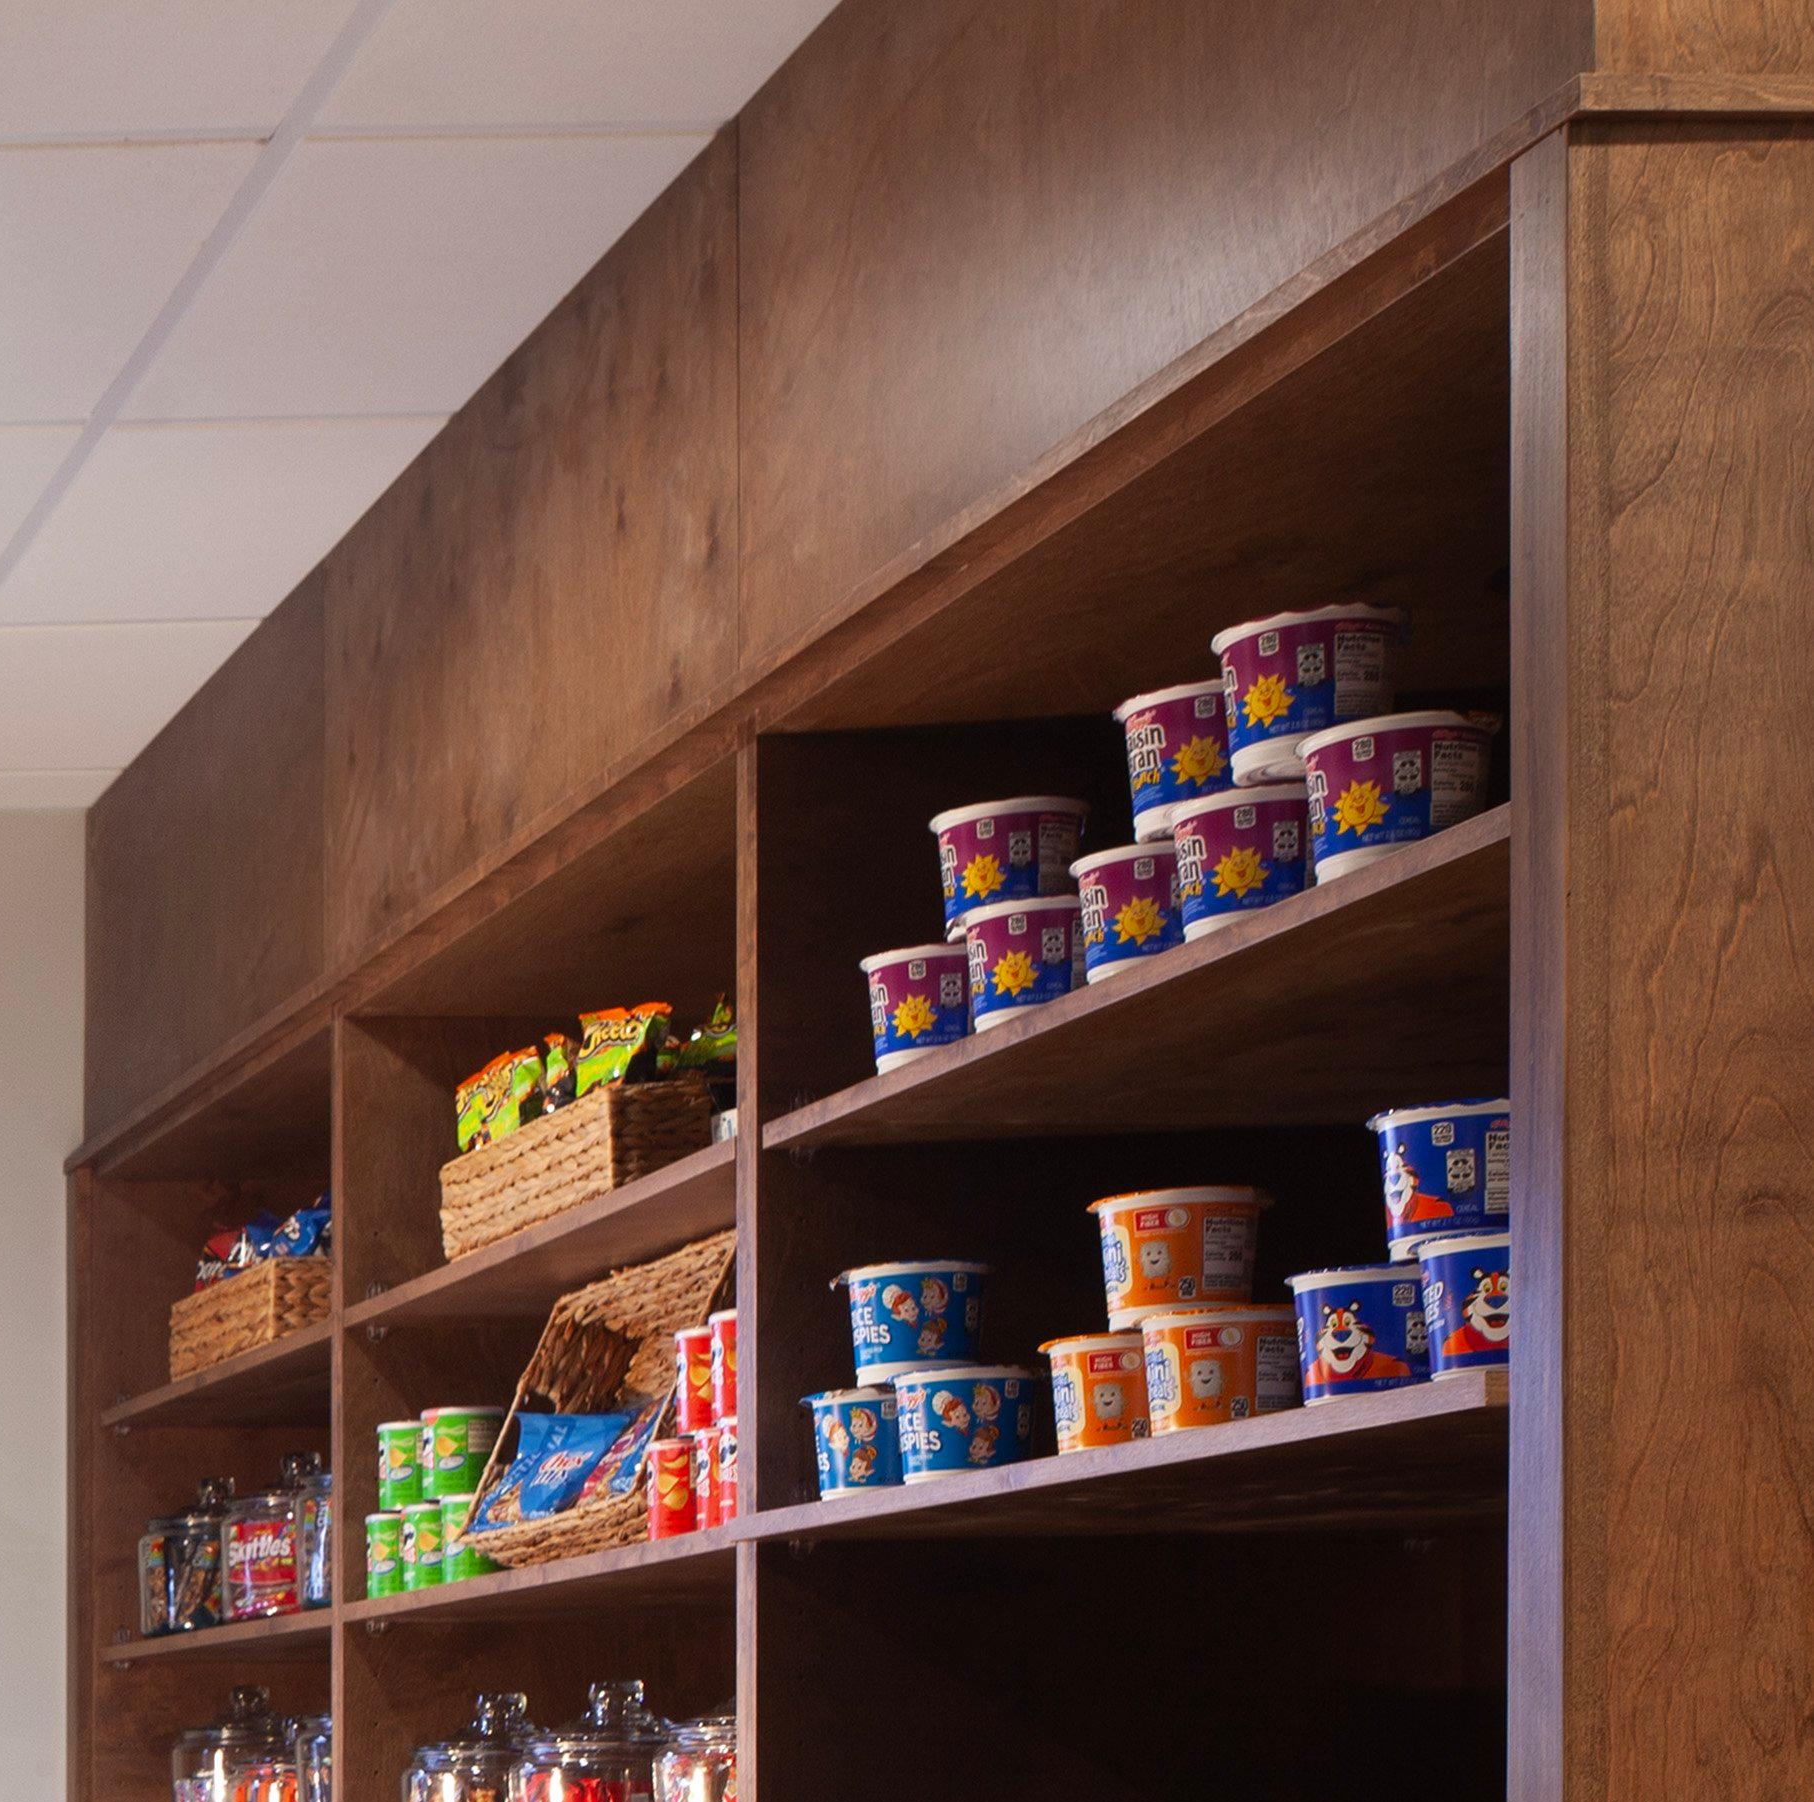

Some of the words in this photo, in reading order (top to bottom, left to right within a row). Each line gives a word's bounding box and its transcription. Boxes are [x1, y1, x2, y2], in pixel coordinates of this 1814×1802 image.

[1432, 1124, 1452, 1136] 220
[1394, 1286, 1414, 1298] 220
[228, 1531, 291, 1570] Skittles
